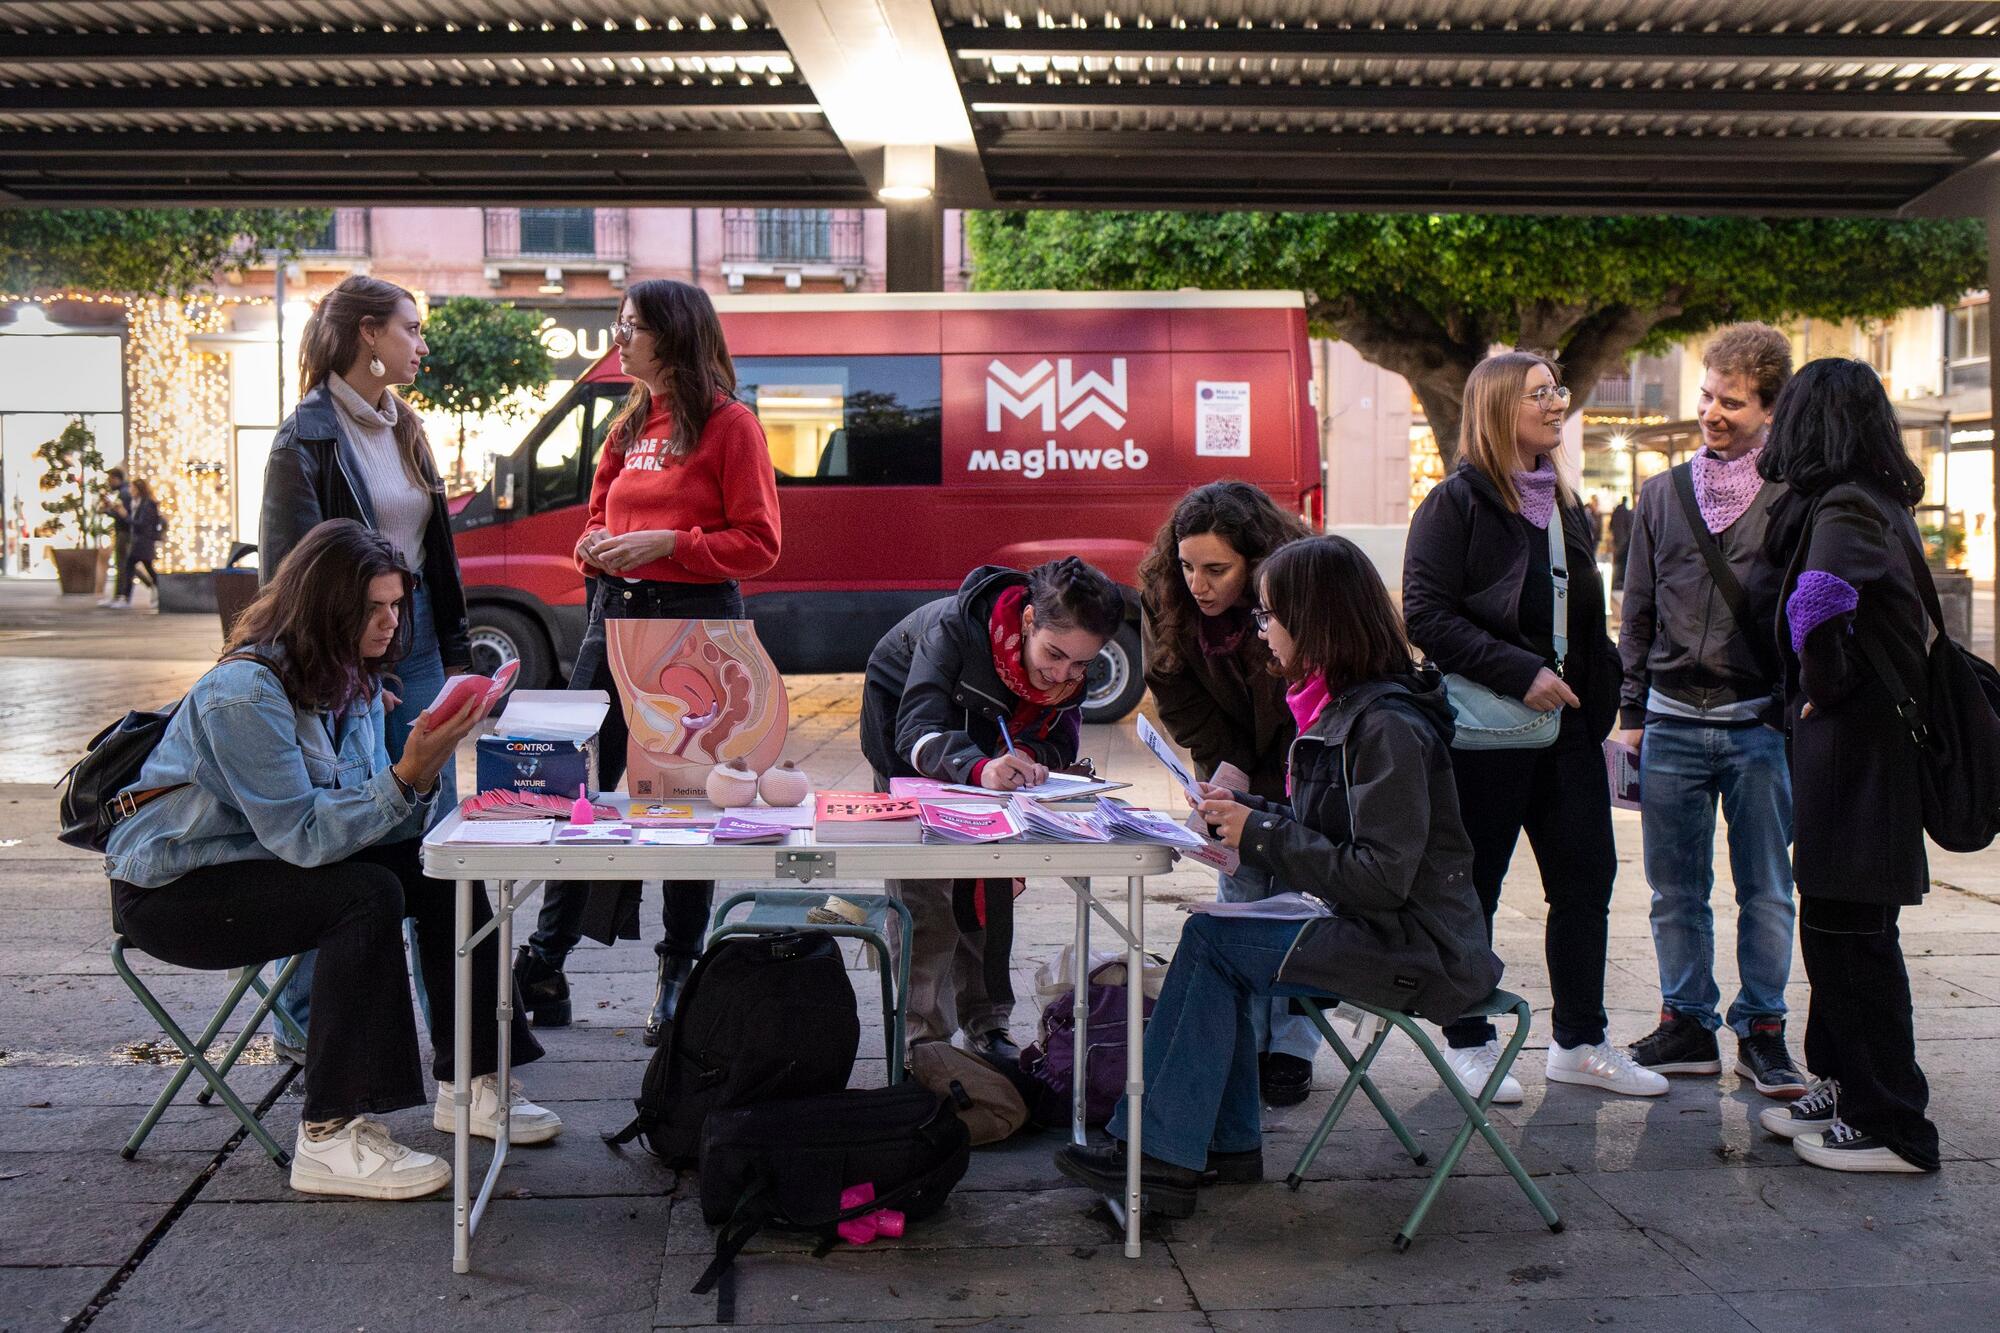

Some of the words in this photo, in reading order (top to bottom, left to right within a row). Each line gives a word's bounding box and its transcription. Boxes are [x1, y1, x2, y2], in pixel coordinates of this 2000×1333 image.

[986, 357, 1128, 432] MW
[625, 455, 665, 471] CARE
[967, 439, 1149, 479] maghweb
[506, 743, 556, 752] CONTROL
[514, 779, 546, 787] NATURE
